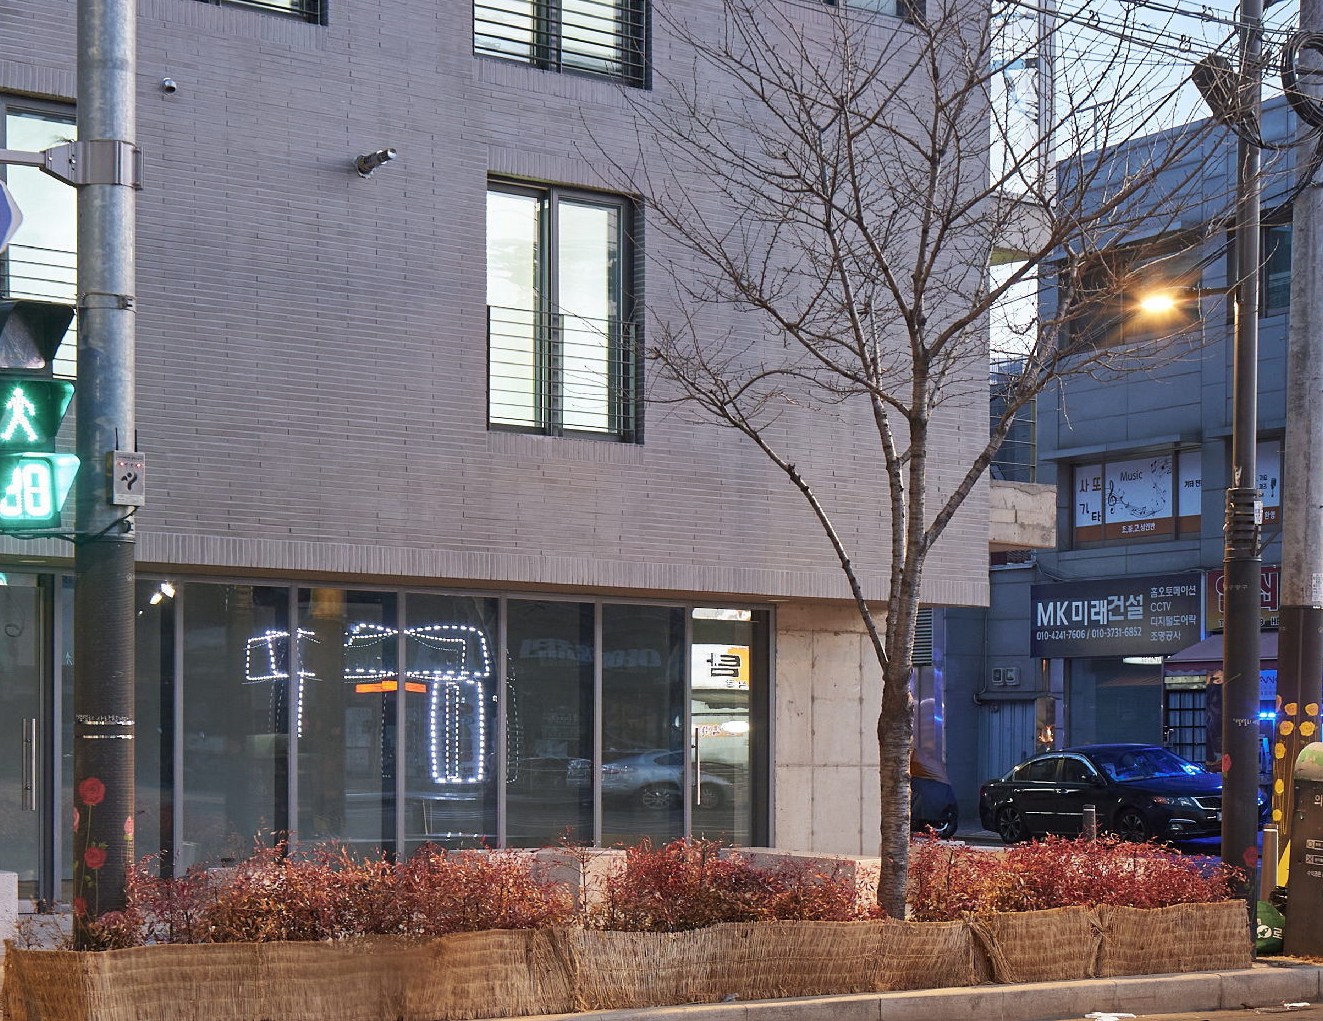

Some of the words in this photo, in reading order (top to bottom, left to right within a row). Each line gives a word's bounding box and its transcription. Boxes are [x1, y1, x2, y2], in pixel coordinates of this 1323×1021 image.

[1120, 470, 1143, 482] Music
[1150, 585, 1196, 598] 홈오토메이션
[1150, 601, 1172, 612] CCTV
[1150, 614, 1197, 627] 디지털도어락
[1036, 629, 1086, 641] 010-4241-7606
[1091, 626, 1142, 638] 010-3731-6852
